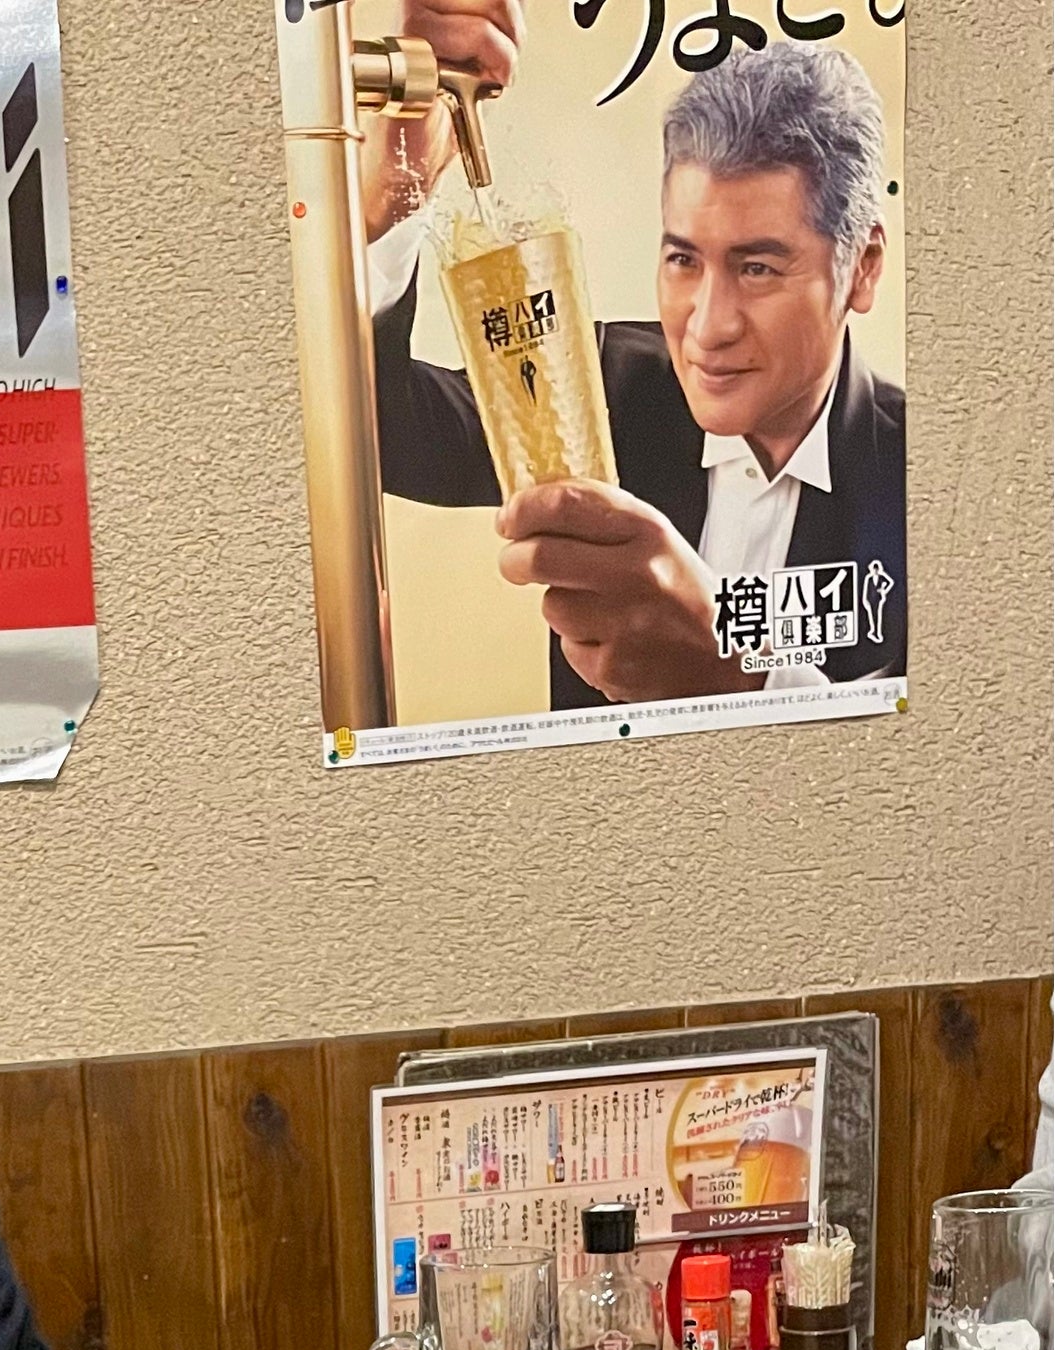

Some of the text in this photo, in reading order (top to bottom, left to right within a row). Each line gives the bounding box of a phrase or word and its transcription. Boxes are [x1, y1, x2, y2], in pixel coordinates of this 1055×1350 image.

[709, 1210, 791, 1226] ドリンクメニュー
